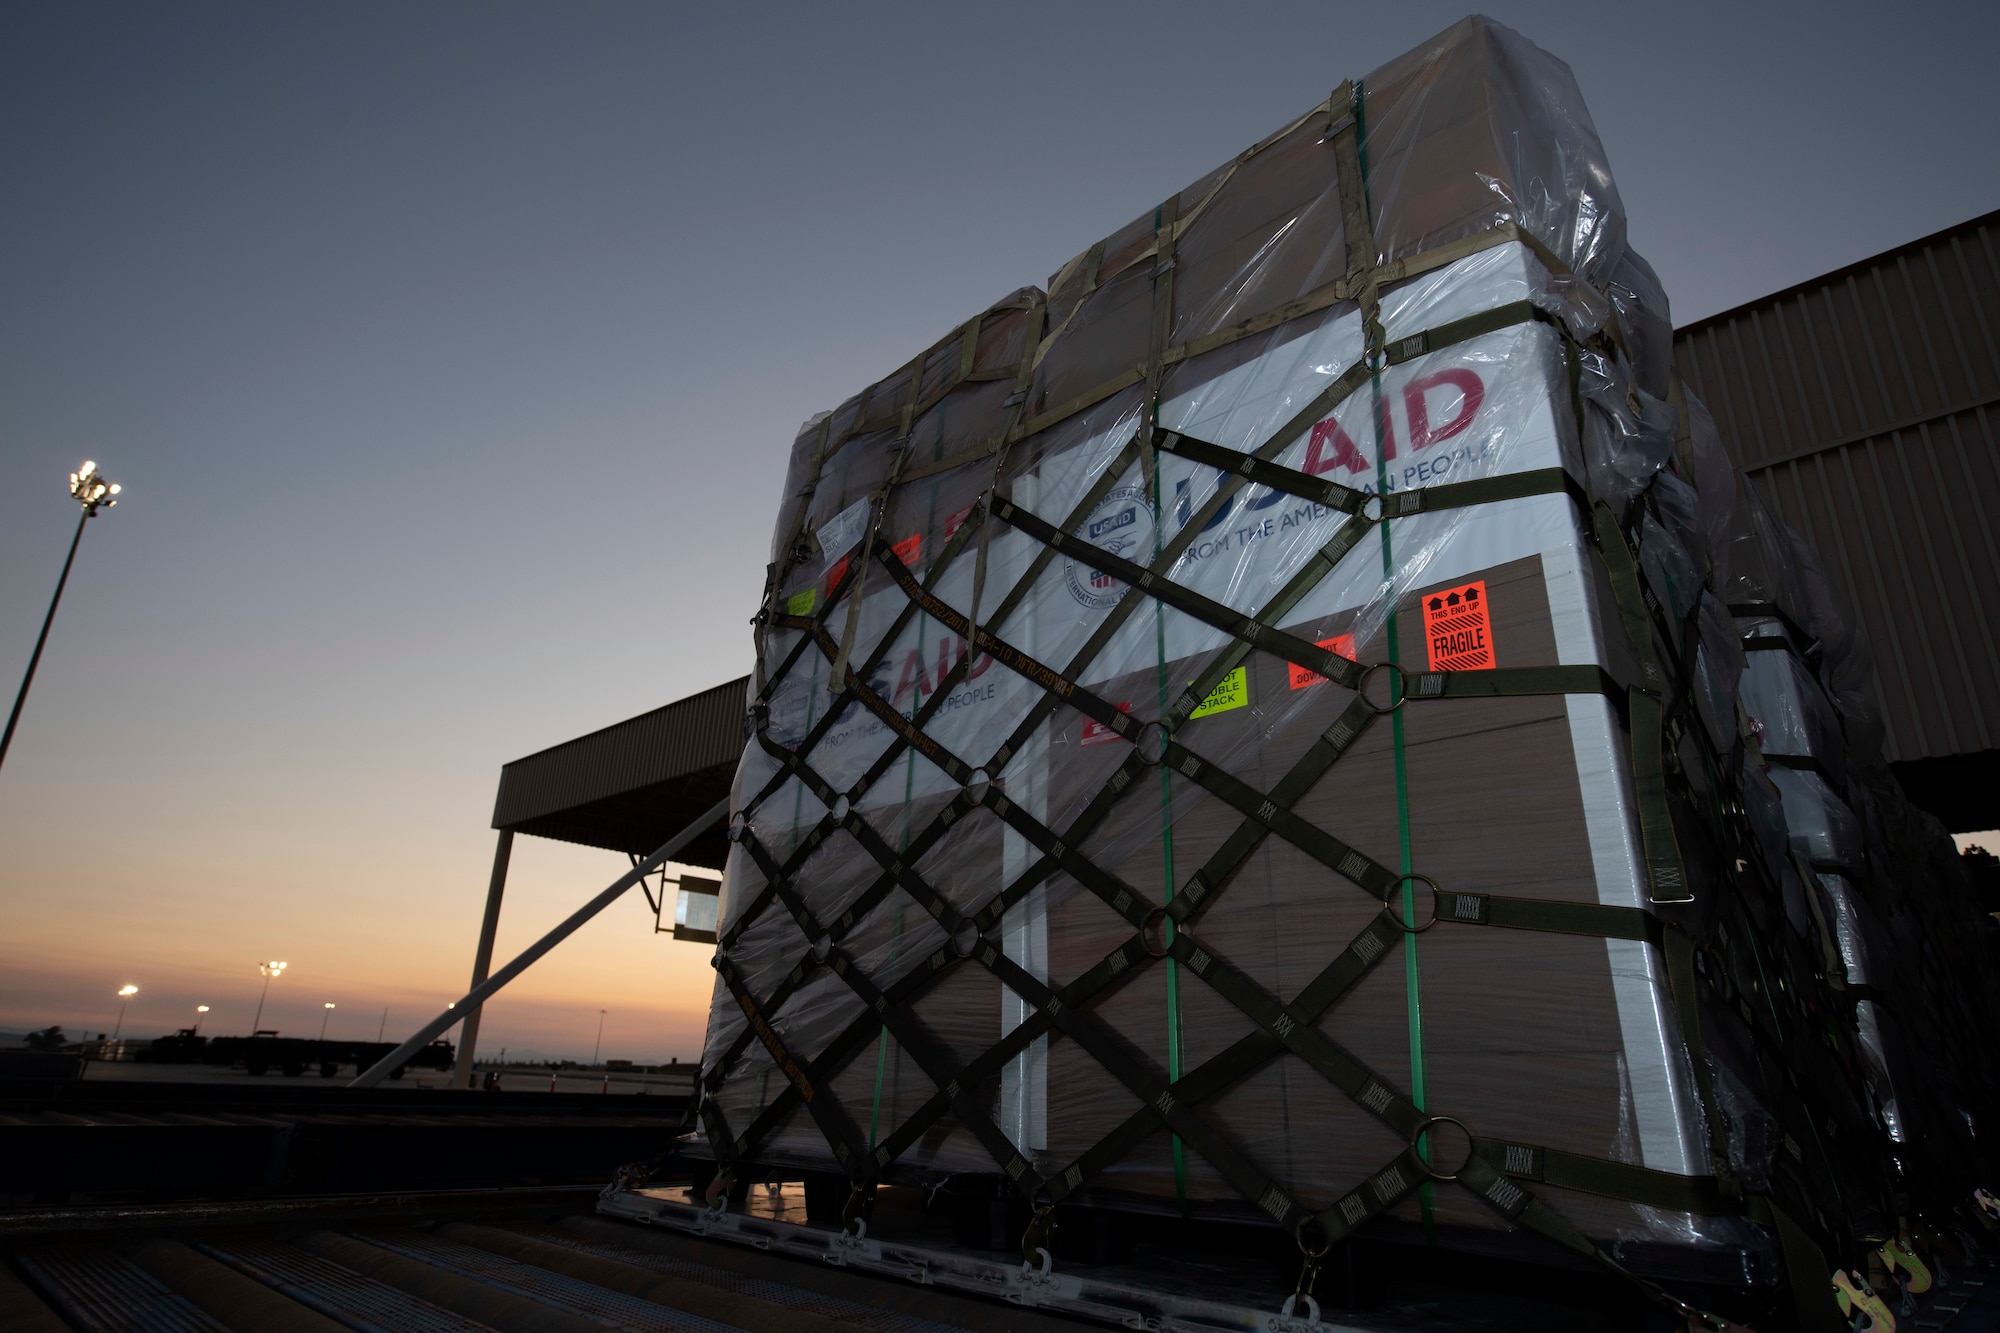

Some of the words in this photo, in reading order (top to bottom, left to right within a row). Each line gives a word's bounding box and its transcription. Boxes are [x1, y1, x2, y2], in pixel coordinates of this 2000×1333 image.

[1182, 535, 1230, 564] ROM
[1236, 519, 1274, 546] THE
[1403, 438, 1494, 487] PEOPLE
[1093, 512, 1131, 537] USAID
[1064, 564, 1118, 606] INTERNATIONAL
[1430, 609, 1448, 621] THIS
[1450, 605, 1467, 616] END
[1468, 601, 1480, 611] UP
[1433, 627, 1485, 659] FRAGILE
[947, 683, 995, 711] PEOPLE
[1199, 693, 1236, 711] STACK
